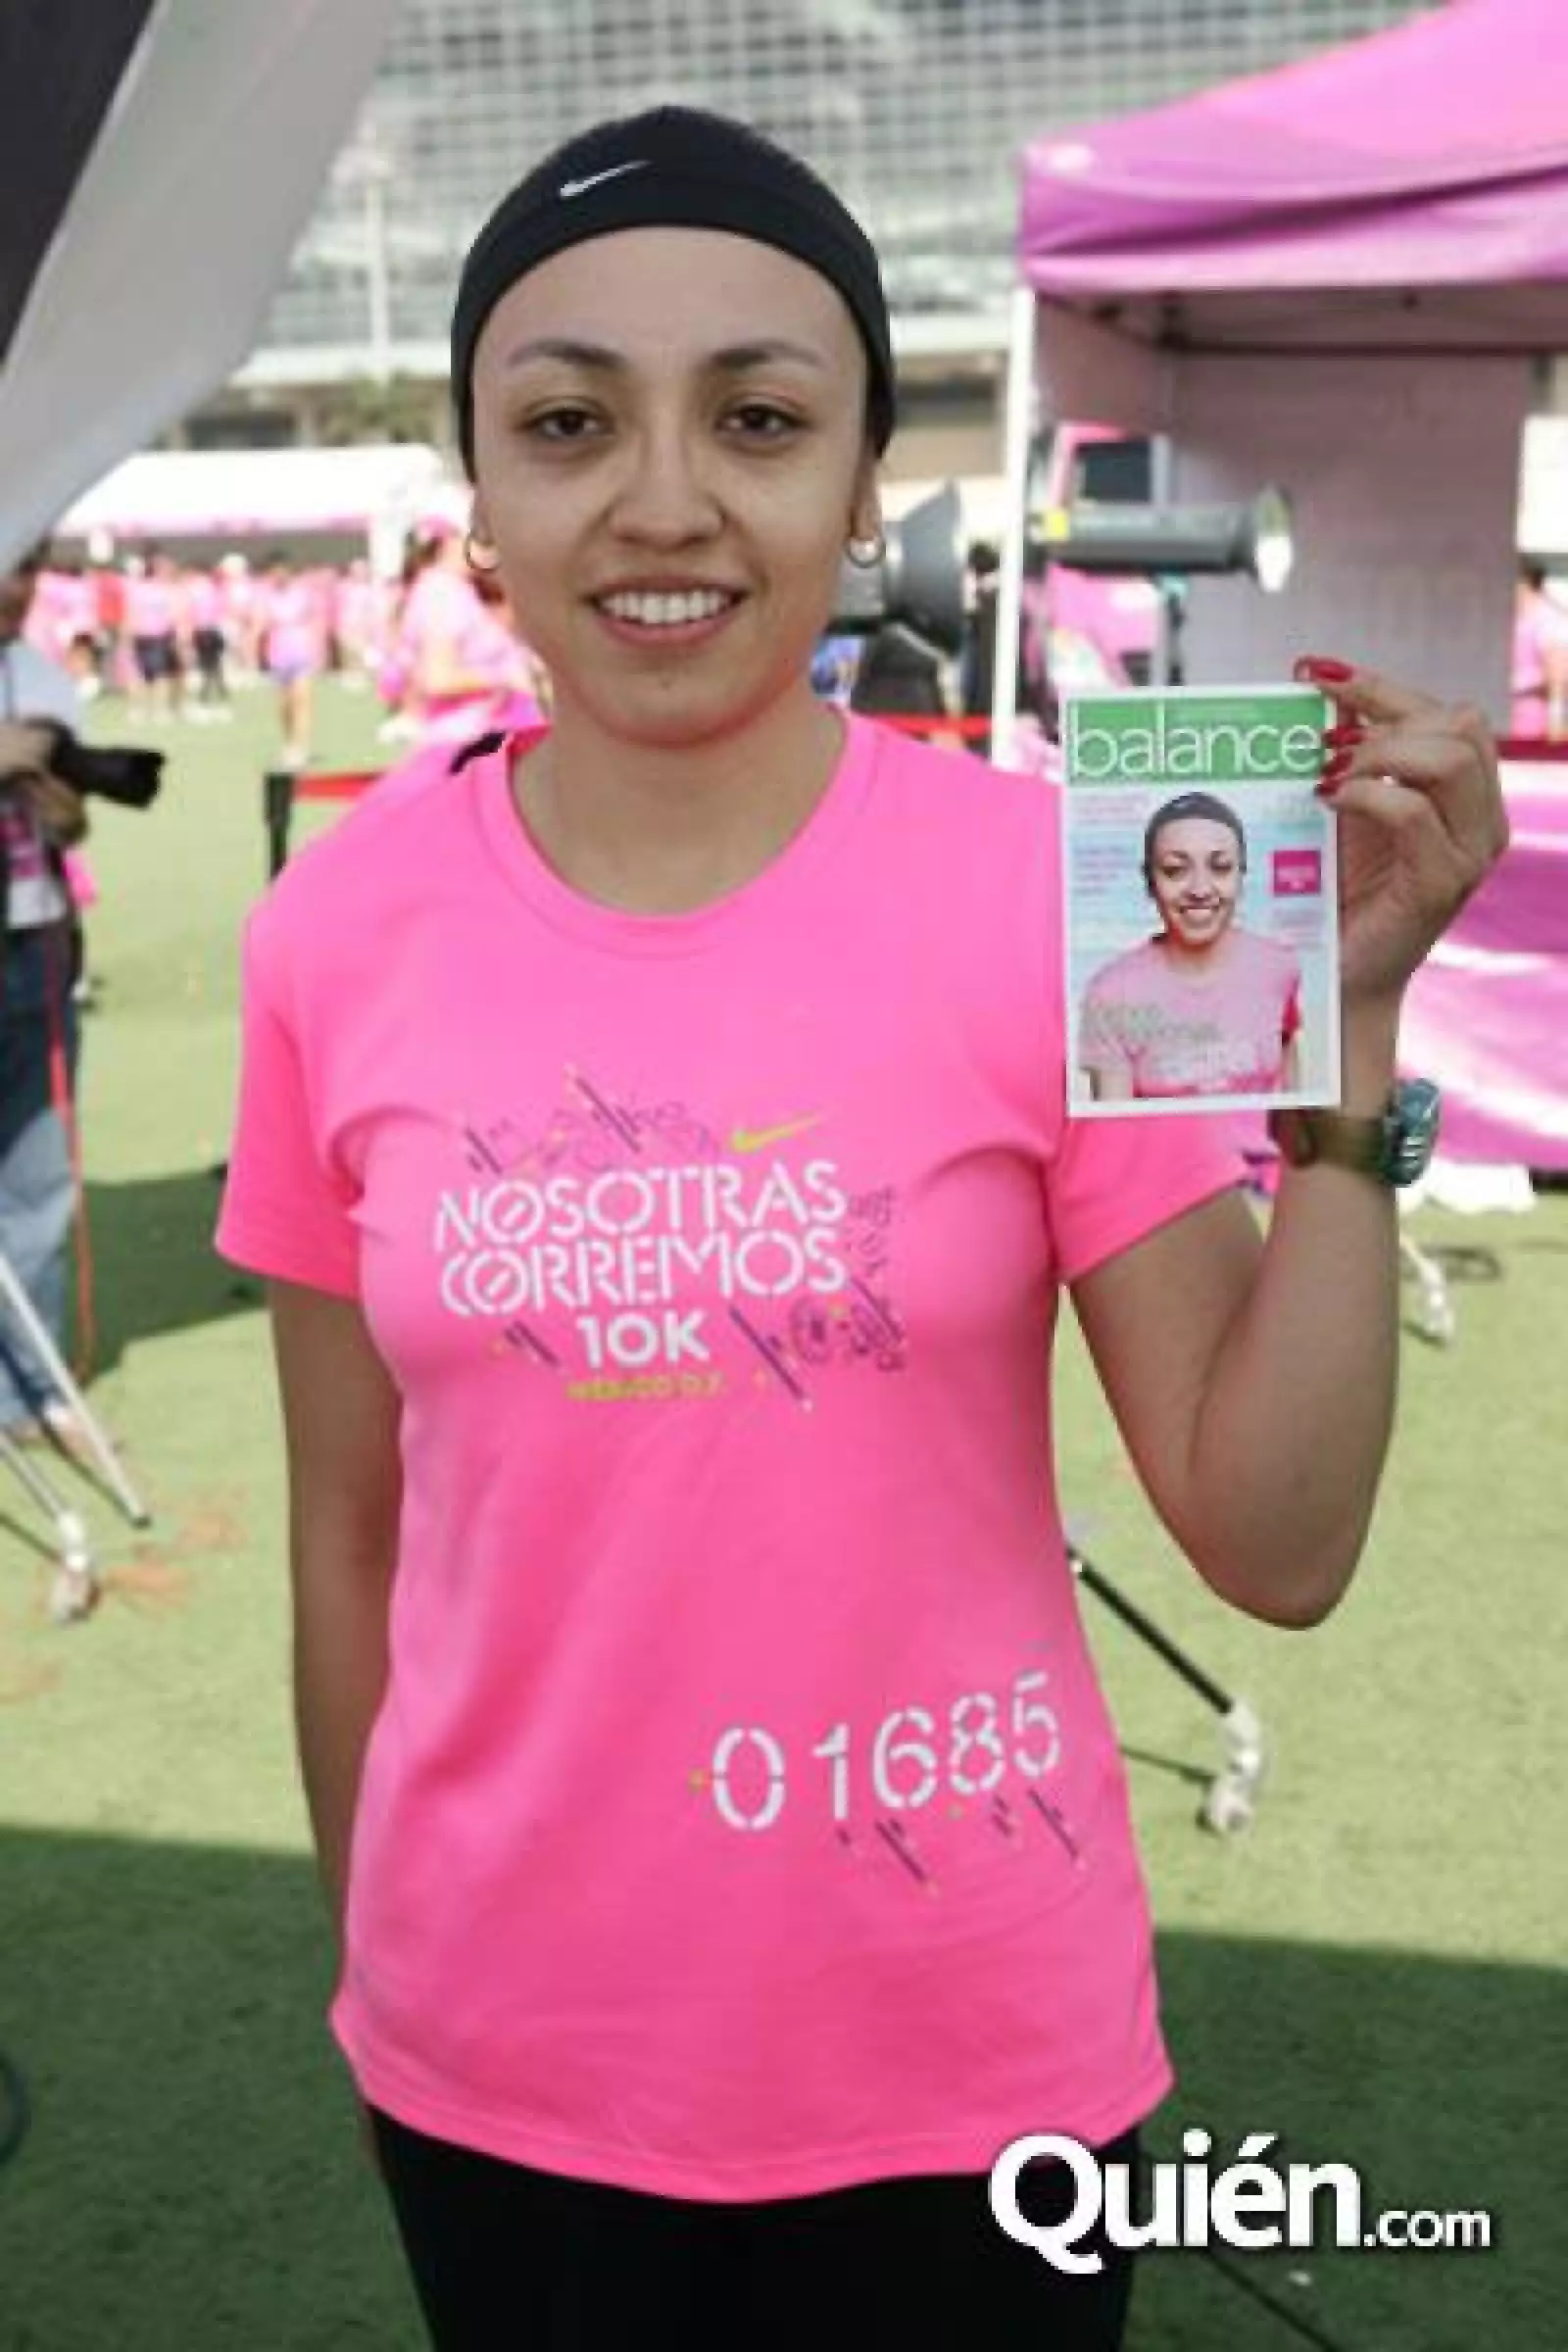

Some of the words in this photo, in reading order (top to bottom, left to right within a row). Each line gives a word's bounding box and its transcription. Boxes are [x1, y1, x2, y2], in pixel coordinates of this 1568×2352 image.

[1069, 702, 1321, 776] balance
[435, 1160, 849, 1250] NOSOTRAS
[441, 1228, 850, 1314] CORREMOS
[577, 1309, 709, 1367] 10K
[712, 1671, 1060, 1831] 01685
